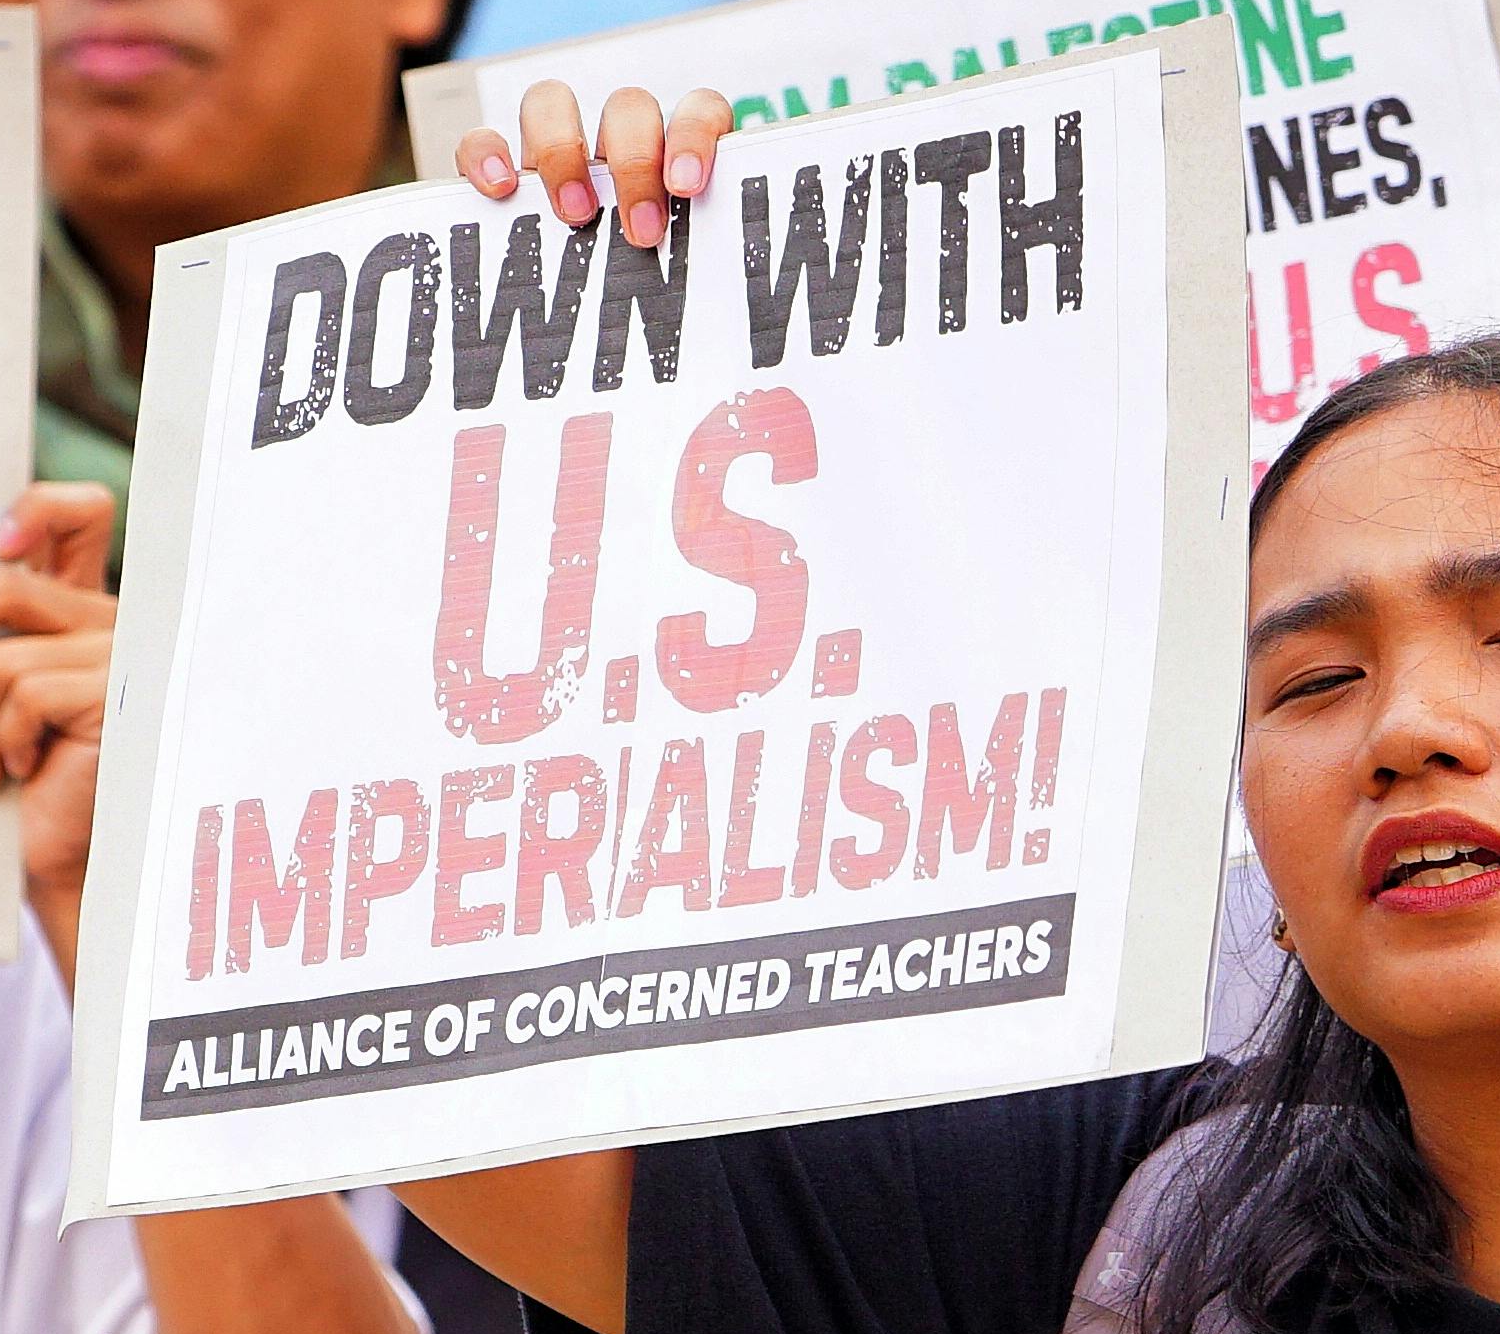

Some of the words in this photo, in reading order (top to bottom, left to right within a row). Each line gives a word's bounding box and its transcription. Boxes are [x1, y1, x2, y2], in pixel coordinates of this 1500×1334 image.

[252, 198, 690, 449] DOWN
[741, 110, 1083, 369] WITH
[1247, 97, 1447, 233] NES,
[434, 385, 863, 745] U.S.
[185, 687, 1067, 982] IMPERIALISM!
[163, 1012, 410, 1093] ALLIANCE
[424, 1005, 490, 1053] OF
[505, 957, 792, 1046] CONCERNED
[804, 919, 1053, 1002] TEACHERS
